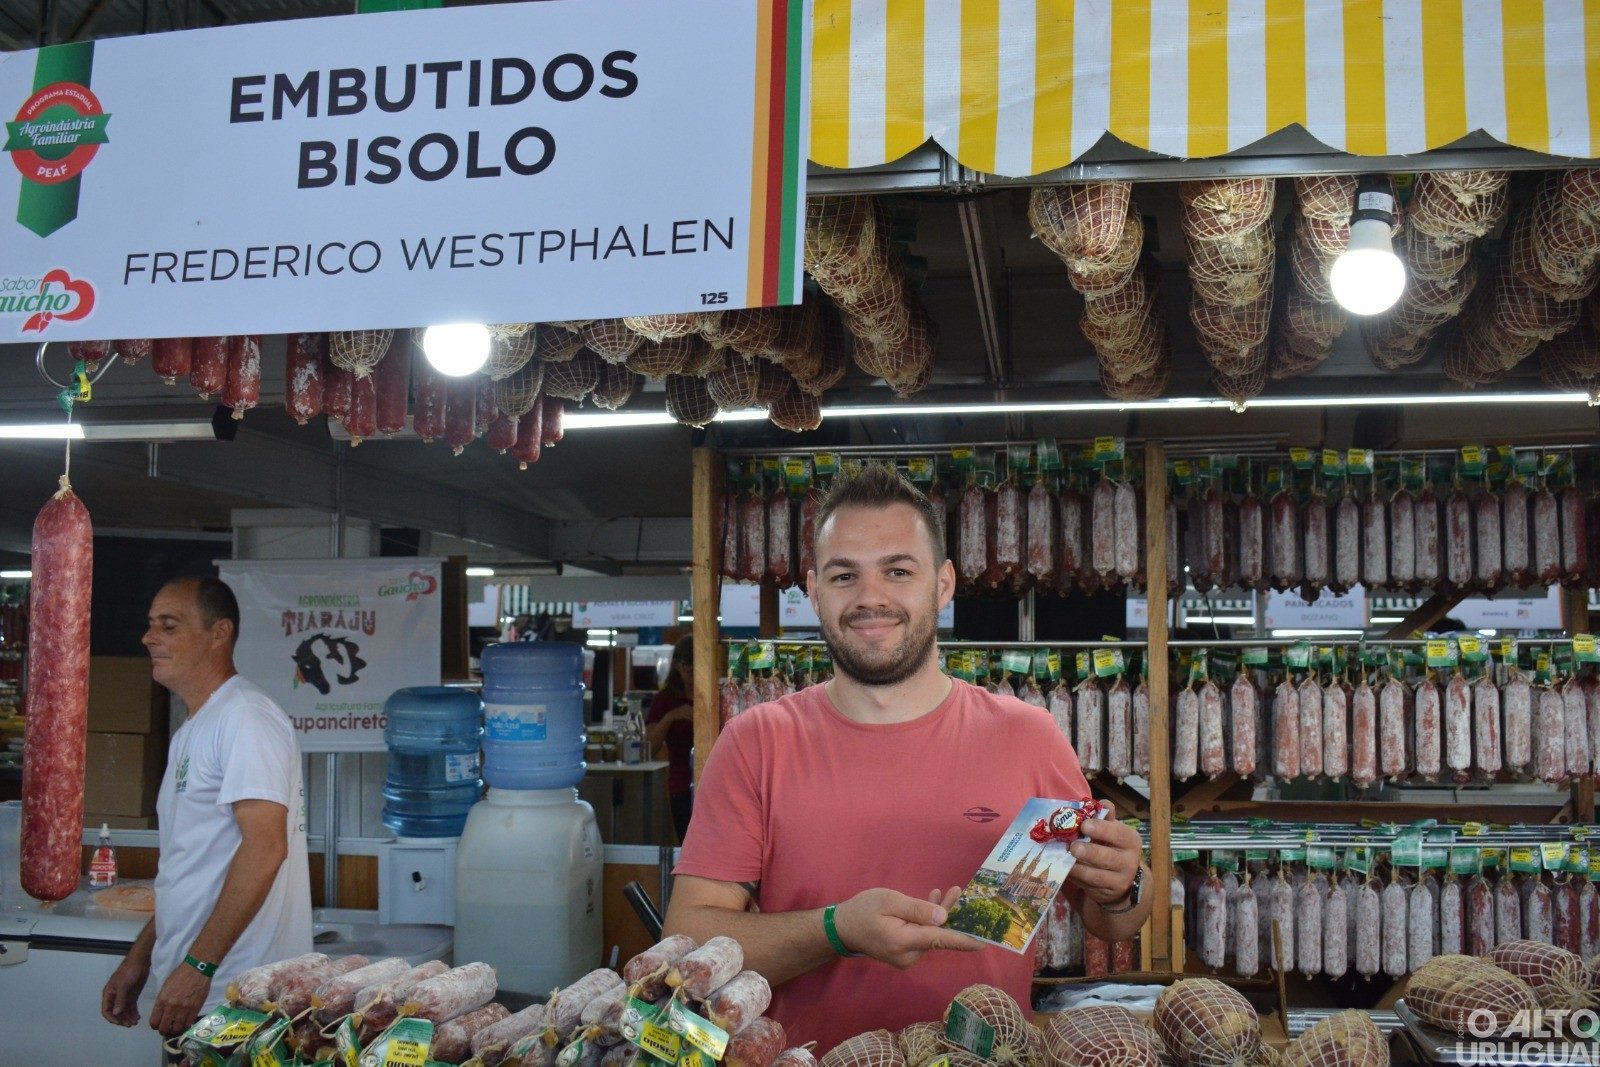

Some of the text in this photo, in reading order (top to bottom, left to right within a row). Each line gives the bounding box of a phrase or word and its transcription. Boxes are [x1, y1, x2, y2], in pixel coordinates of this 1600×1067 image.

[230, 50, 640, 123] EMBUTIDOS
[27, 89, 93, 115] PROGRAMA ESTADUAL
[19, 118, 96, 137] Agroindústria
[31, 132, 81, 147] Familiar
[36, 164, 68, 178] PEAF
[298, 126, 557, 189] BISOLO
[124, 217, 735, 286] FREDERICO WESTPHALEN
[0, 282, 71, 312] aúcho
[700, 292, 729, 305] 125
[281, 609, 377, 637] TIARAJU
